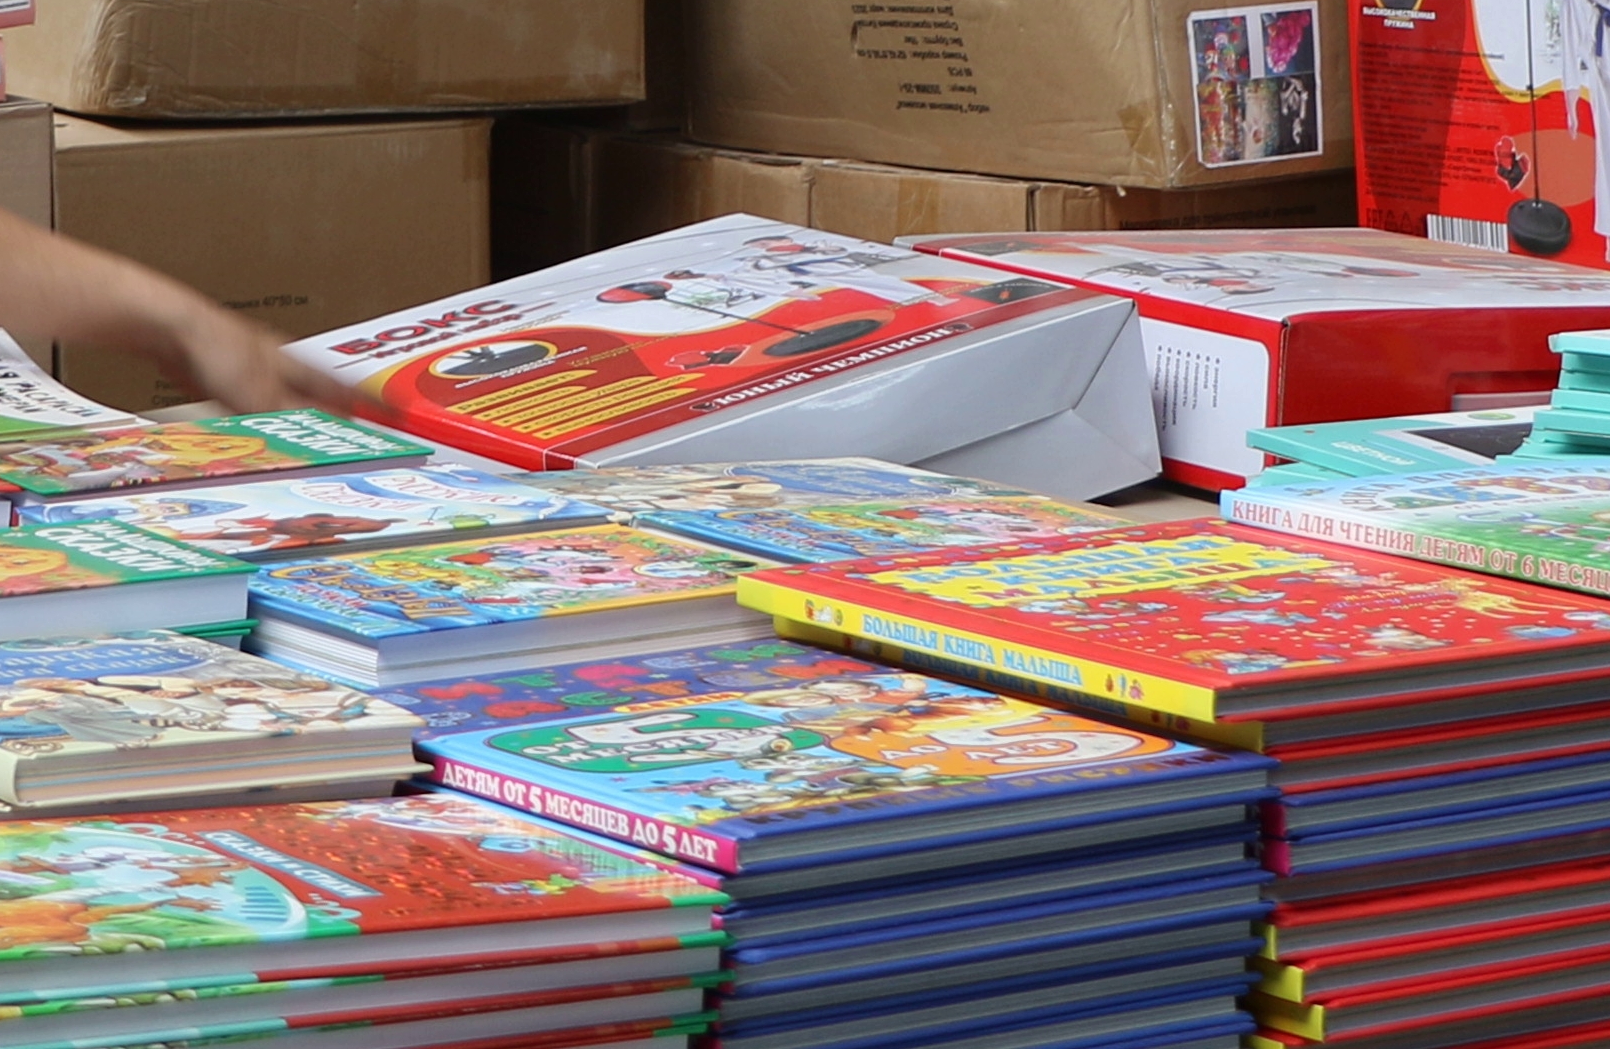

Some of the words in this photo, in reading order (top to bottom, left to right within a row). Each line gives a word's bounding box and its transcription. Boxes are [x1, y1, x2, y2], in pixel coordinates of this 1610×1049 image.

[328, 300, 516, 356] БОКС
[715, 371, 814, 406] ЮНЫЙ
[811, 328, 953, 373] ЧЕМПИОН
[36, 527, 175, 573] СКАЗКИ
[1232, 500, 1293, 529] КНИГА
[1297, 511, 1334, 537] ДЛЯ
[1339, 522, 1416, 553] ЧТЕНИЯ
[1419, 535, 1485, 566] ДЕТЯМ
[1489, 550, 1517, 573] ОТ
[1521, 555, 1533, 575] 6
[862, 613, 938, 651] БОЛЬШАЯ
[942, 633, 997, 665] КНИГА
[1002, 647, 1084, 687] МАЛЫША
[442, 762, 503, 802] ДЕТЯМ
[504, 780, 528, 805] ОТ
[529, 787, 543, 813] 5
[544, 792, 630, 839] МЕСЯЦЕВ
[632, 819, 660, 846] ДО
[661, 825, 677, 854] 5
[679, 834, 719, 863] ЛЕТ
